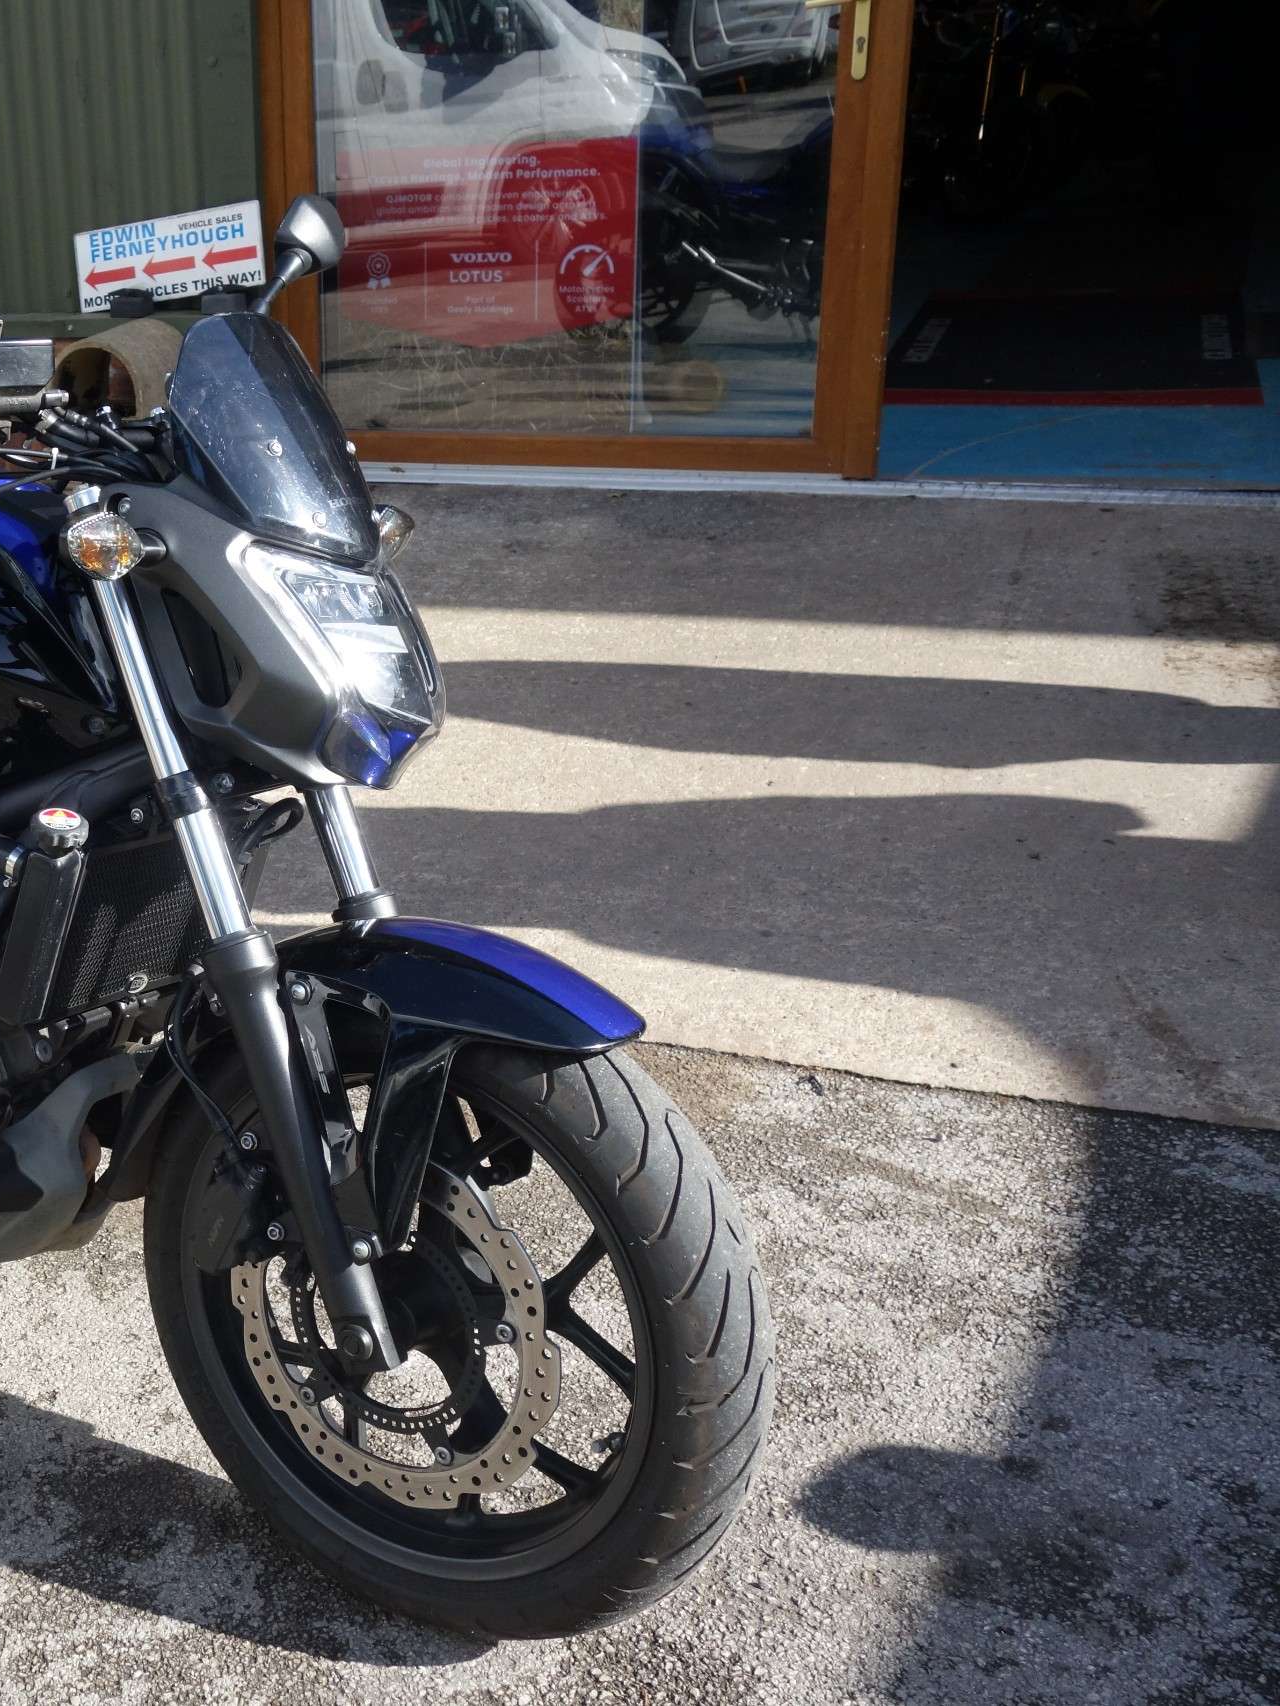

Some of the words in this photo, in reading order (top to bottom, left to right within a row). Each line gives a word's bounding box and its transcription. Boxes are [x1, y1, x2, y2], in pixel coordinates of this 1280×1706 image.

[516, 167, 600, 178] Performance.
[385, 193, 433, 204] QJMOTOR
[178, 218, 213, 231] VEHICLE
[215, 213, 243, 224] SALES
[89, 222, 156, 248] EDWIN
[91, 223, 245, 263] FERNEYHOUGH
[449, 252, 512, 264] VOLVO
[449, 270, 504, 283] LOTUS
[84, 293, 120, 308] MOR
[144, 281, 188, 298] ICLES
[192, 276, 224, 291] THIS
[227, 270, 262, 286] WAY!
[304, 1024, 331, 1095] ABS
